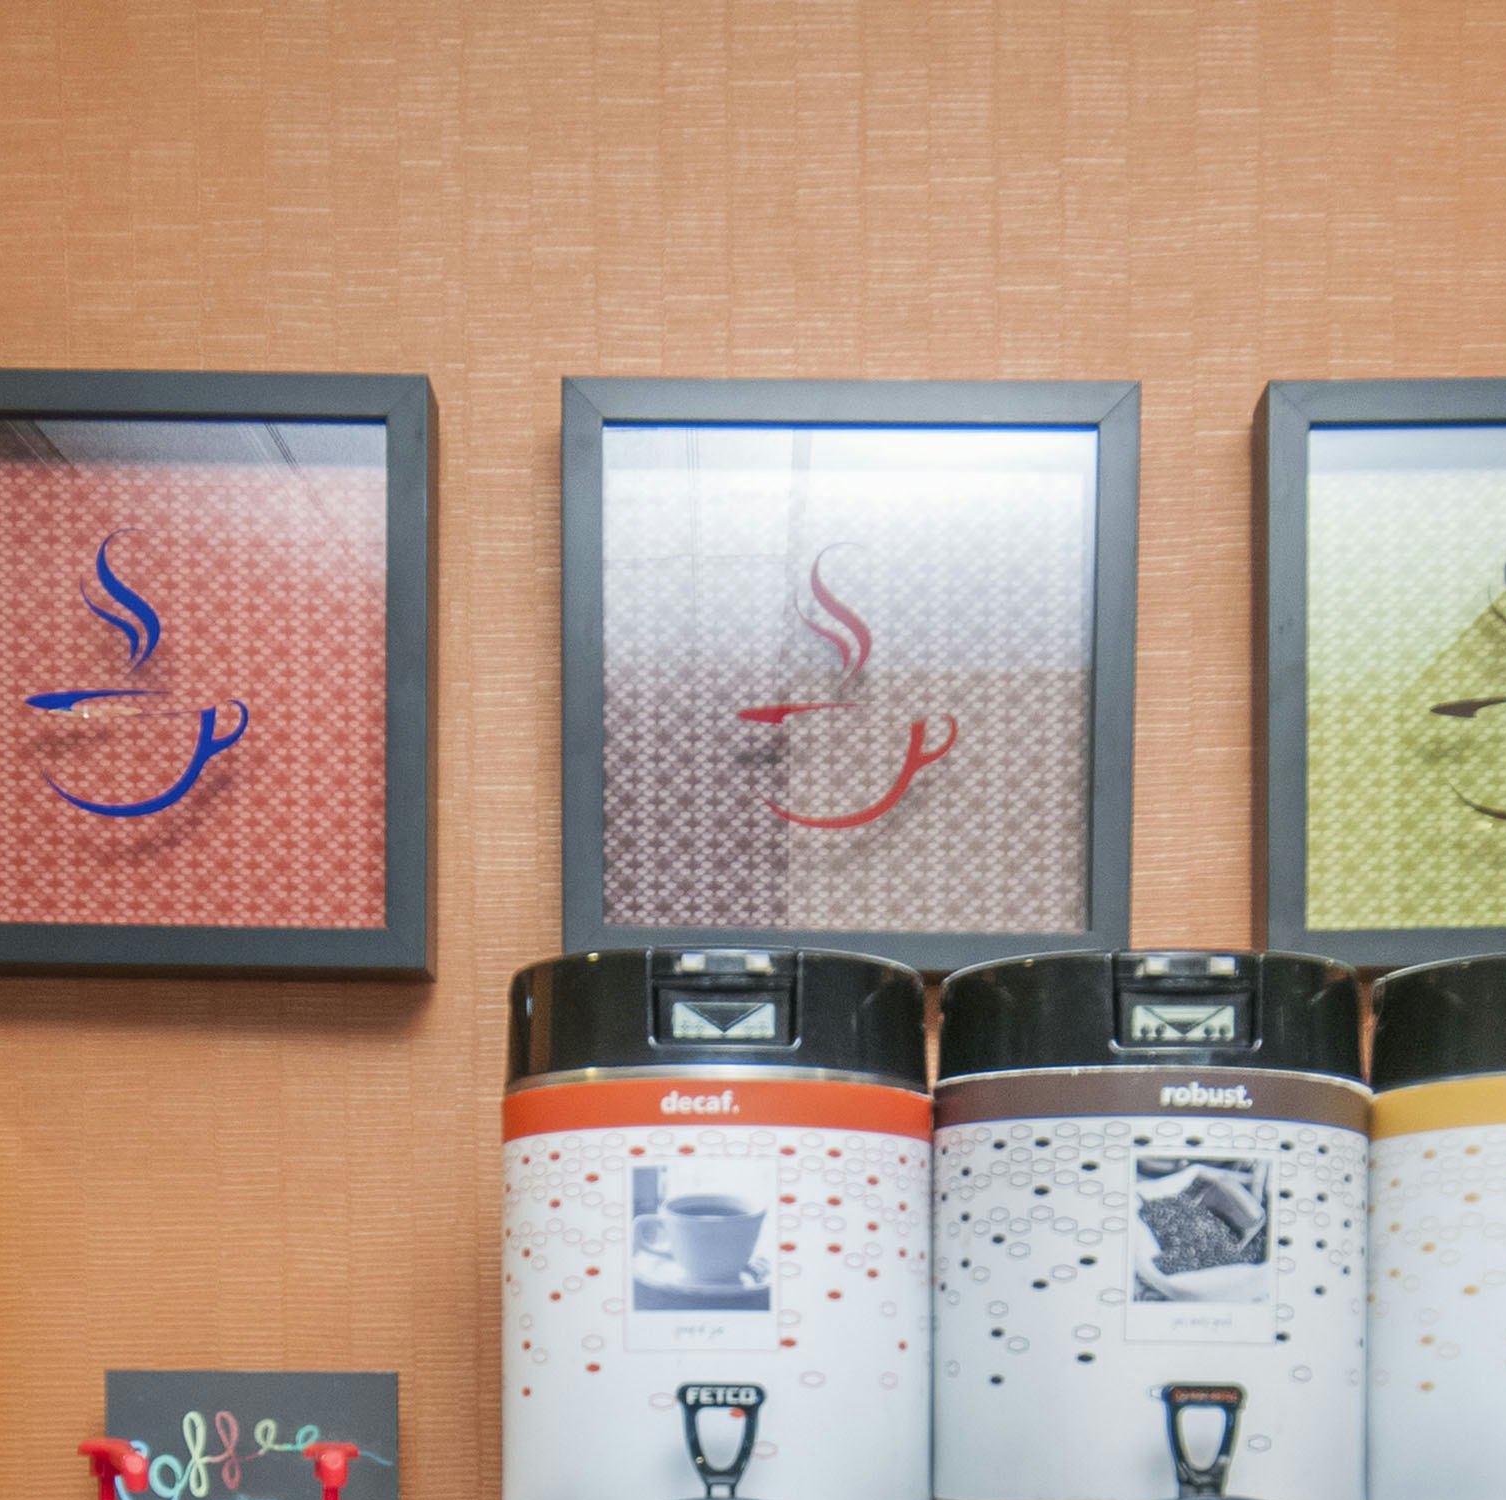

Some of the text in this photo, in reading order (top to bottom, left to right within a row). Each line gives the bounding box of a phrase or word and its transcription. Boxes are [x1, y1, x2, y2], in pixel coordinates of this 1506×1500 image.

[660, 1090, 740, 1114] decaf.
[1160, 1082, 1253, 1109] robust.
[685, 1386, 758, 1404] FETCO
